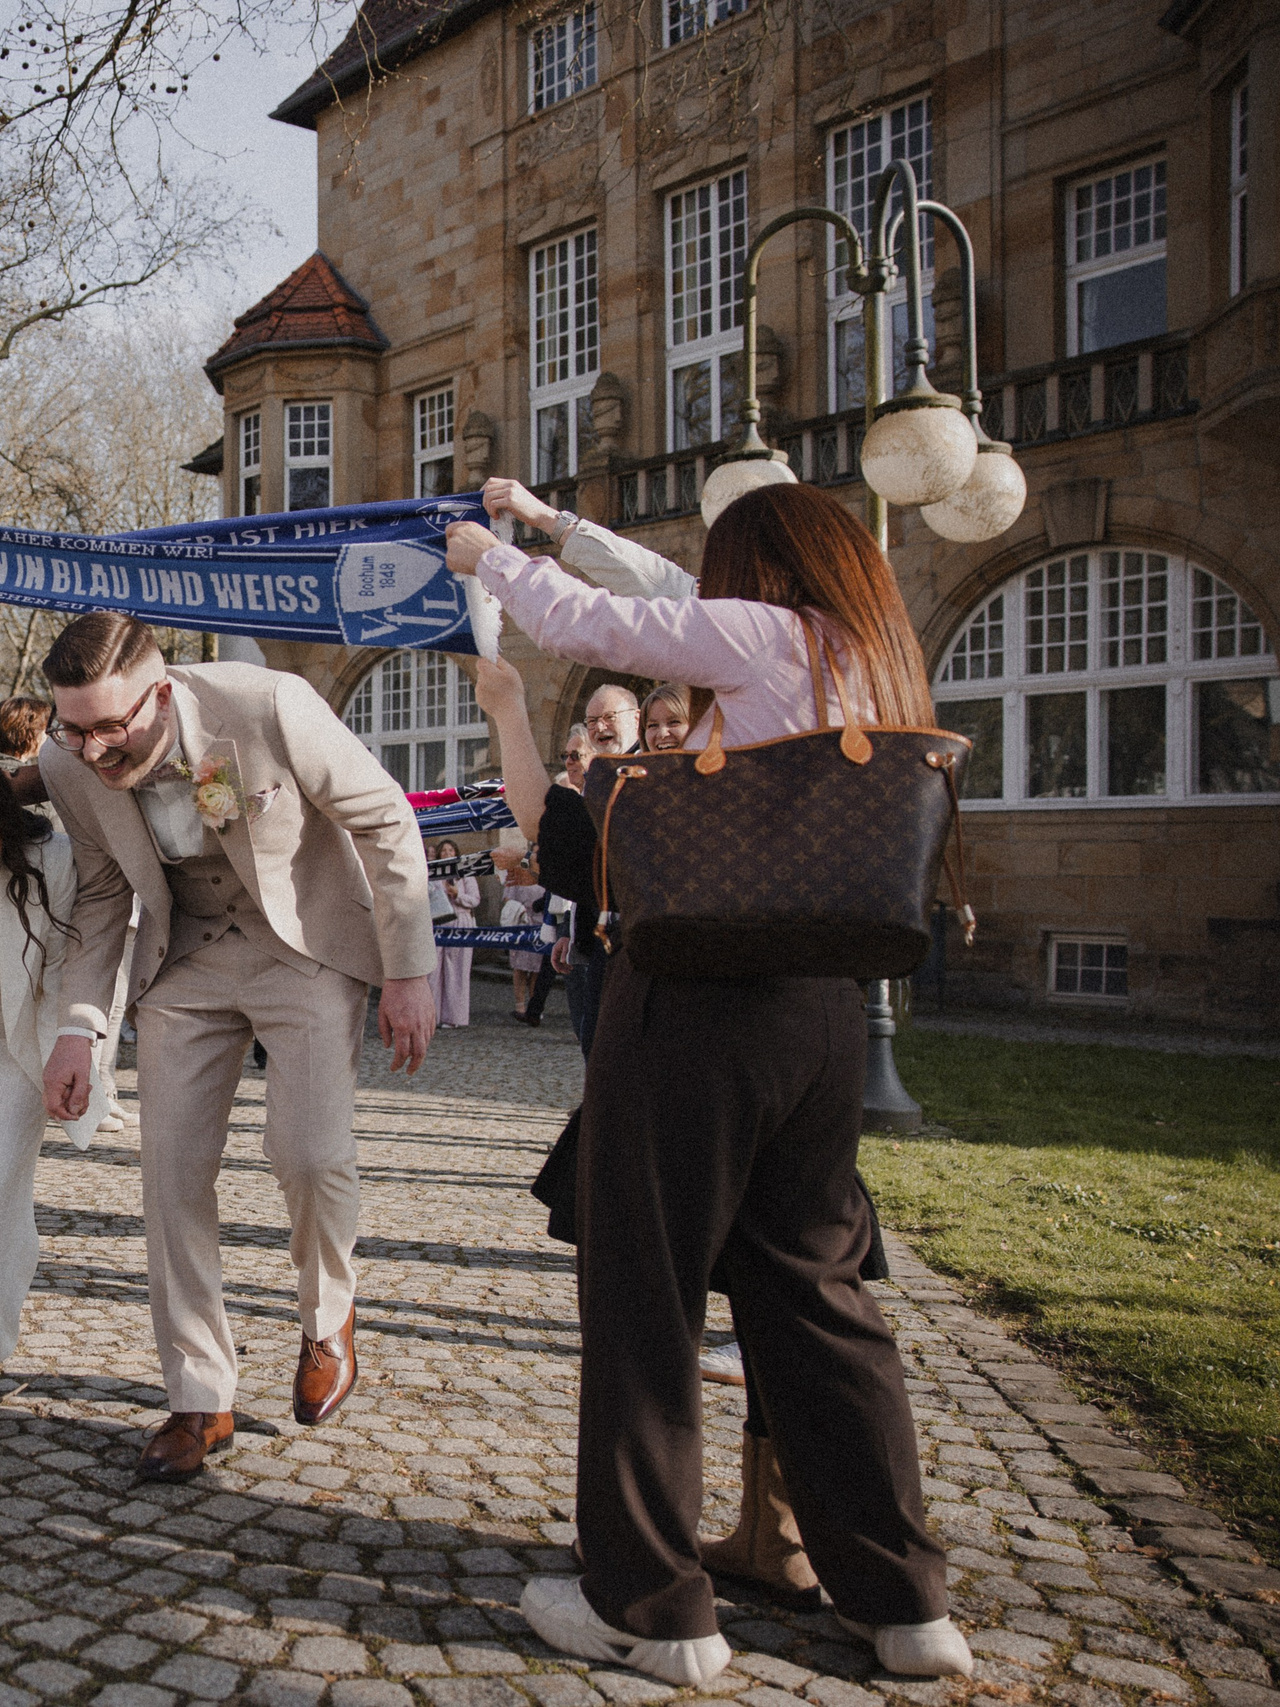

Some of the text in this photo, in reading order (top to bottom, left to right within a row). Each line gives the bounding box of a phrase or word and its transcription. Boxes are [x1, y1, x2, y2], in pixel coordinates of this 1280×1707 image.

[229, 526, 280, 546] IST
[294, 517, 369, 541] HIER
[64, 537, 158, 558] KOMMEN
[163, 546, 214, 560] WIR!
[14, 553, 46, 591] IN
[51, 558, 131, 600] BLAU
[138, 567, 205, 607] UND
[210, 573, 321, 614] WEISS
[359, 555, 375, 597] Bochum
[379, 563, 396, 589] 1848
[55, 601, 86, 611] ZU
[447, 929, 475, 940] IST
[475, 930, 514, 943] HIER
